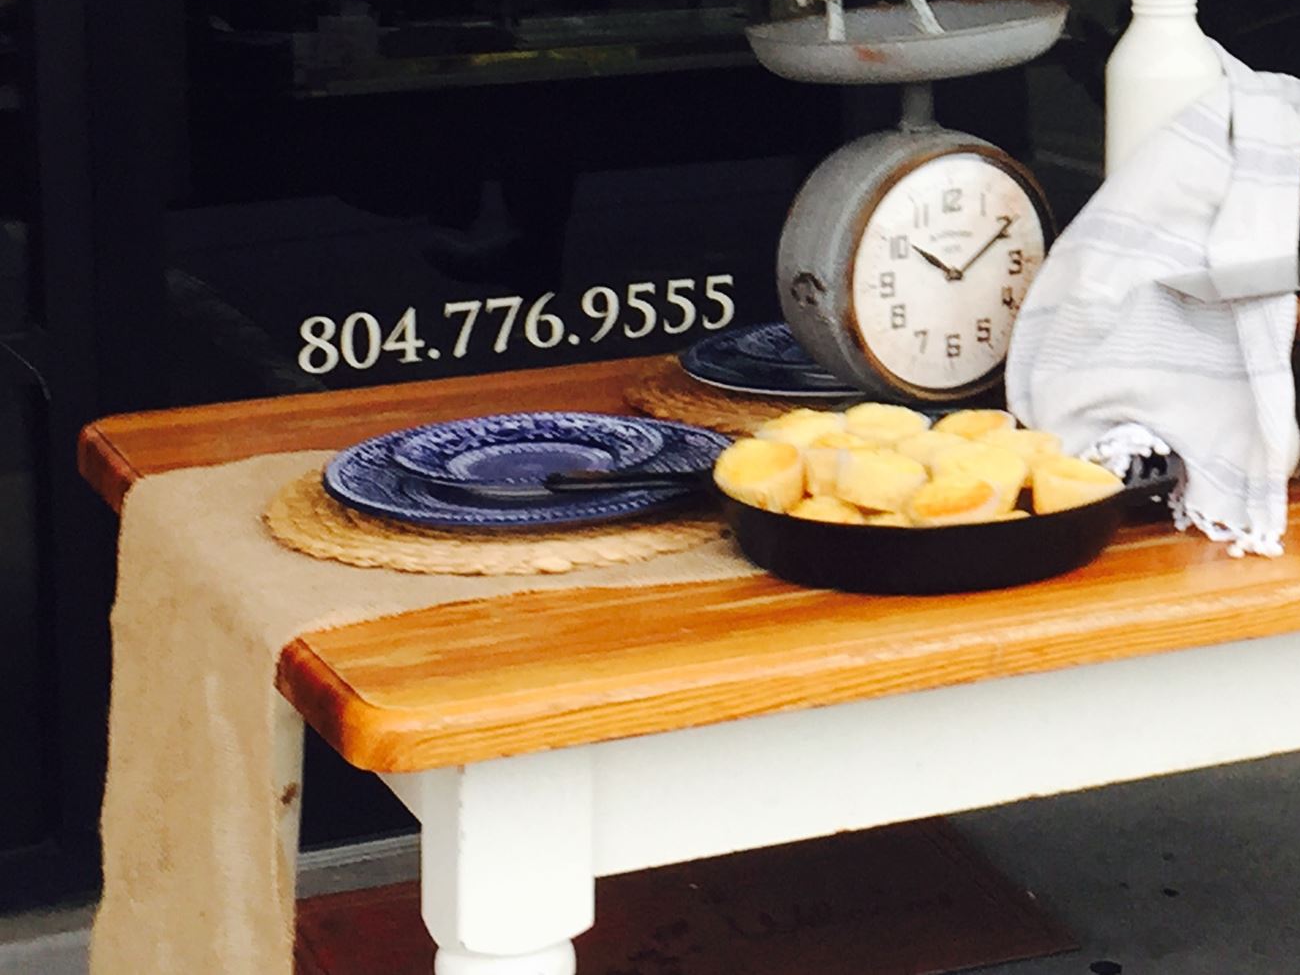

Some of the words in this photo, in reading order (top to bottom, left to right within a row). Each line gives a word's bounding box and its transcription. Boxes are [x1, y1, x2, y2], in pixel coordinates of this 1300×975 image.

[890, 235, 908, 260] 10
[1008, 249, 1022, 276] 3
[880, 271, 895, 299] 9
[299, 273, 735, 375] 804.776.9555
[976, 317, 991, 343] 5
[914, 330, 928, 355] 7
[946, 334, 961, 358] 6
